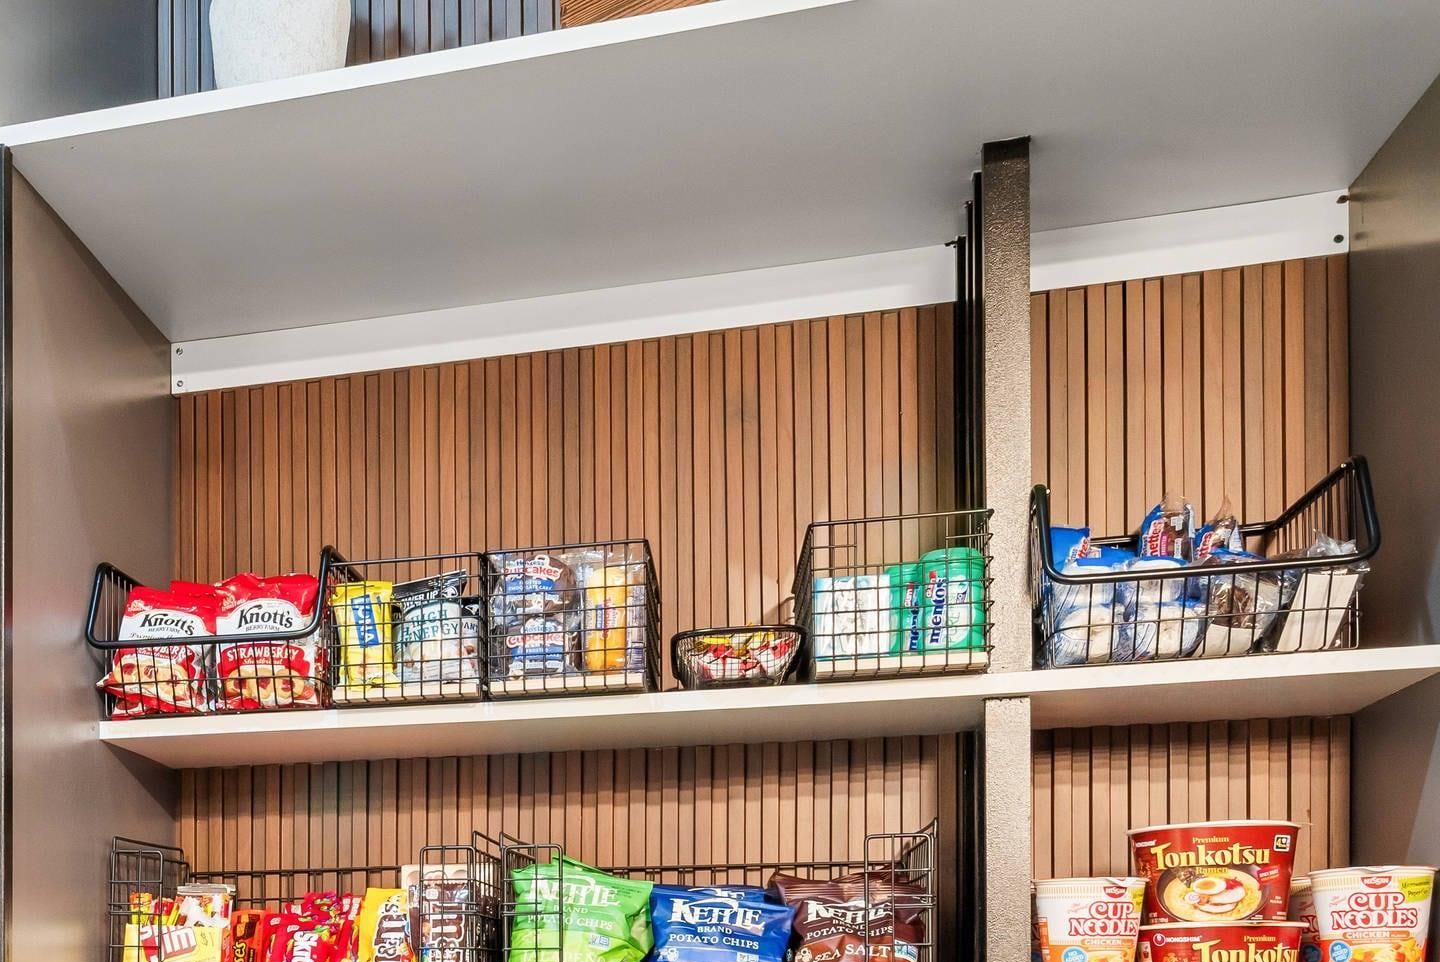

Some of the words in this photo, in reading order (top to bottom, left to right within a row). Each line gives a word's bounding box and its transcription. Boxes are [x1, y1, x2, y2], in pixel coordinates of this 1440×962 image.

[426, 590, 439, 600] UP
[238, 604, 293, 629] Knott's
[409, 610, 449, 628] HIGH
[929, 577, 947, 644] mentos
[140, 613, 195, 636] Knott's
[245, 624, 264, 632] BERRY
[265, 624, 280, 632] FARM
[403, 623, 459, 644] ENERGY
[227, 646, 299, 662] STRAWBERRY
[1192, 836, 1230, 845] Premium
[1150, 842, 1271, 871] Tonkotsu
[1195, 867, 1229, 875] Ramen
[528, 874, 620, 907] KETTLE
[553, 905, 589, 914] BRAND
[1089, 901, 1134, 920] CUP
[1348, 892, 1405, 912] CUP
[667, 897, 766, 929] KETTLE
[803, 900, 893, 925] KETTLE
[1331, 908, 1418, 930] NOODLES
[528, 914, 573, 925] POTATO
[576, 918, 613, 930] CHIPS
[697, 926, 732, 935] BRAND
[669, 933, 719, 944] POTATO
[722, 937, 760, 950] CHIPS
[806, 926, 854, 940] POTATO
[857, 926, 894, 937] CHIPS
[1346, 931, 1390, 939] CHICKEN
[845, 944, 891, 958] SALT
